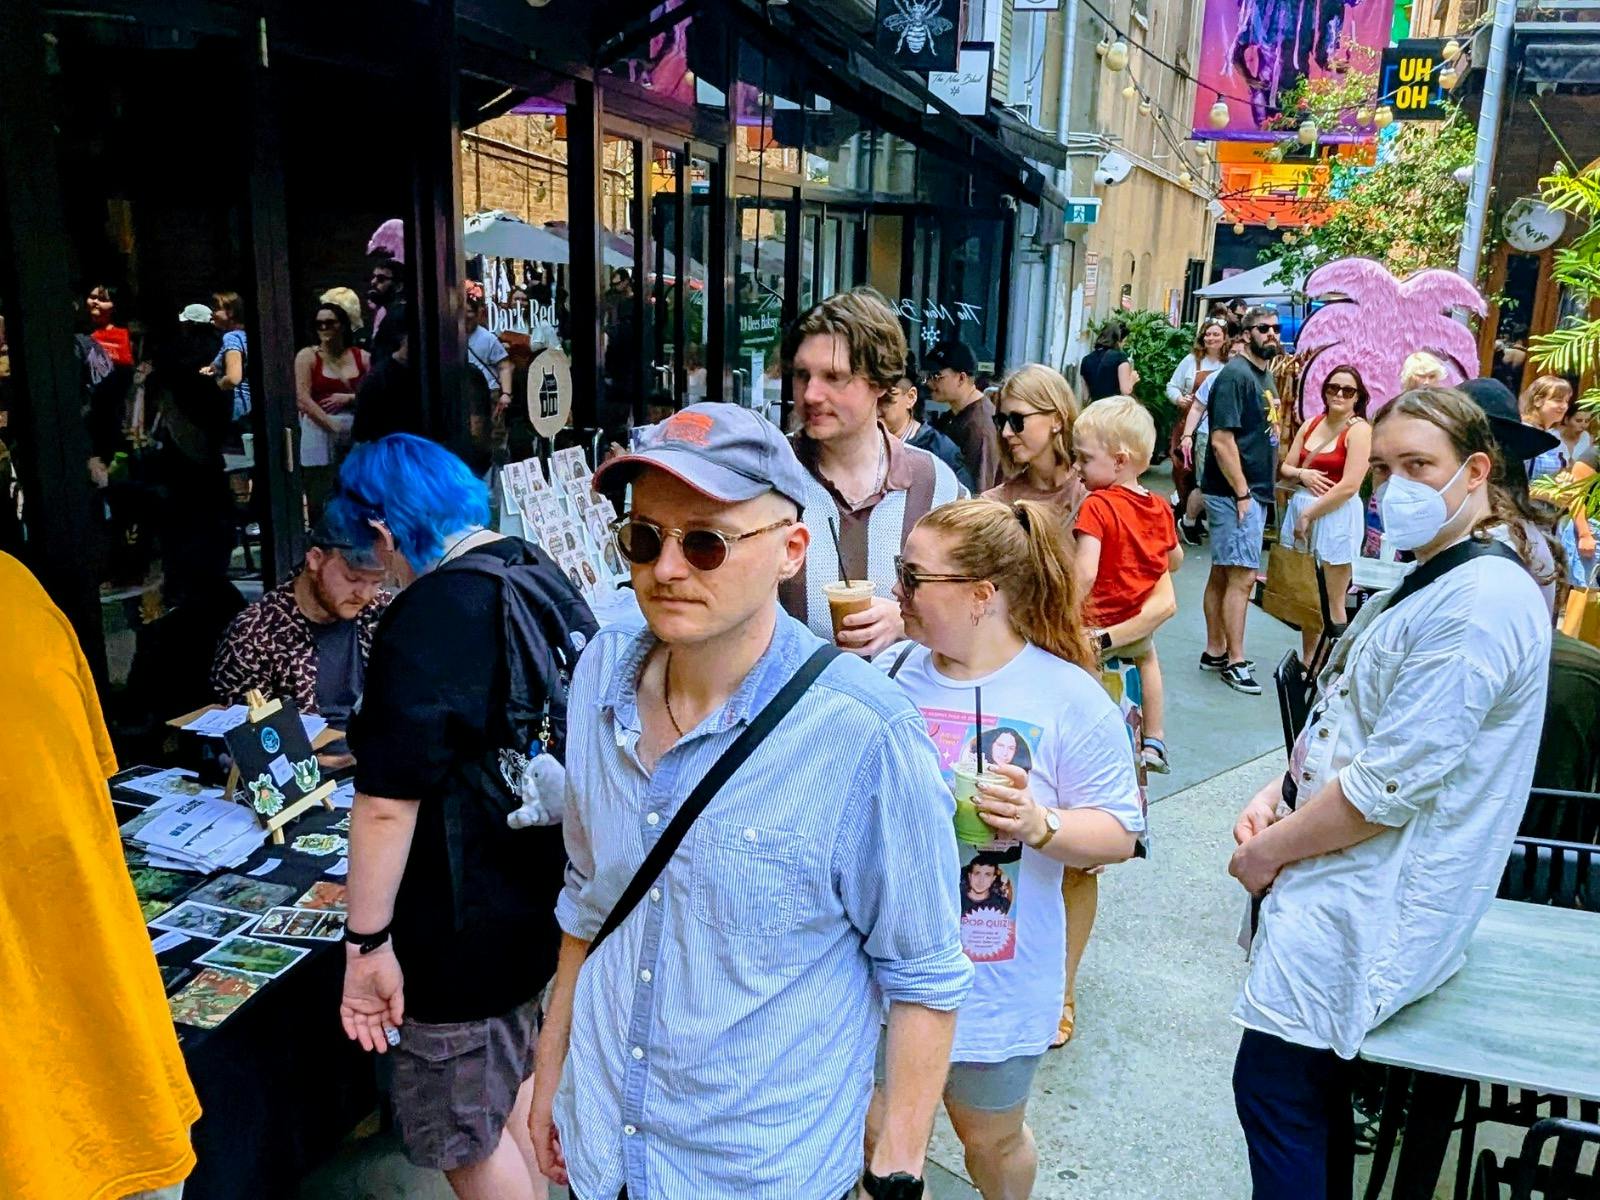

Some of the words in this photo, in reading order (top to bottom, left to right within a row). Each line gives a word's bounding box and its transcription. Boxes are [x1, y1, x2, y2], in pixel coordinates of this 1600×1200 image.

[1399, 58, 1432, 82] UH
[1396, 86, 1429, 110] OH
[487, 299, 527, 333] Dark
[529, 298, 561, 329] Red
[962, 918, 984, 927] POP
[986, 919, 1008, 928] QUIZ
